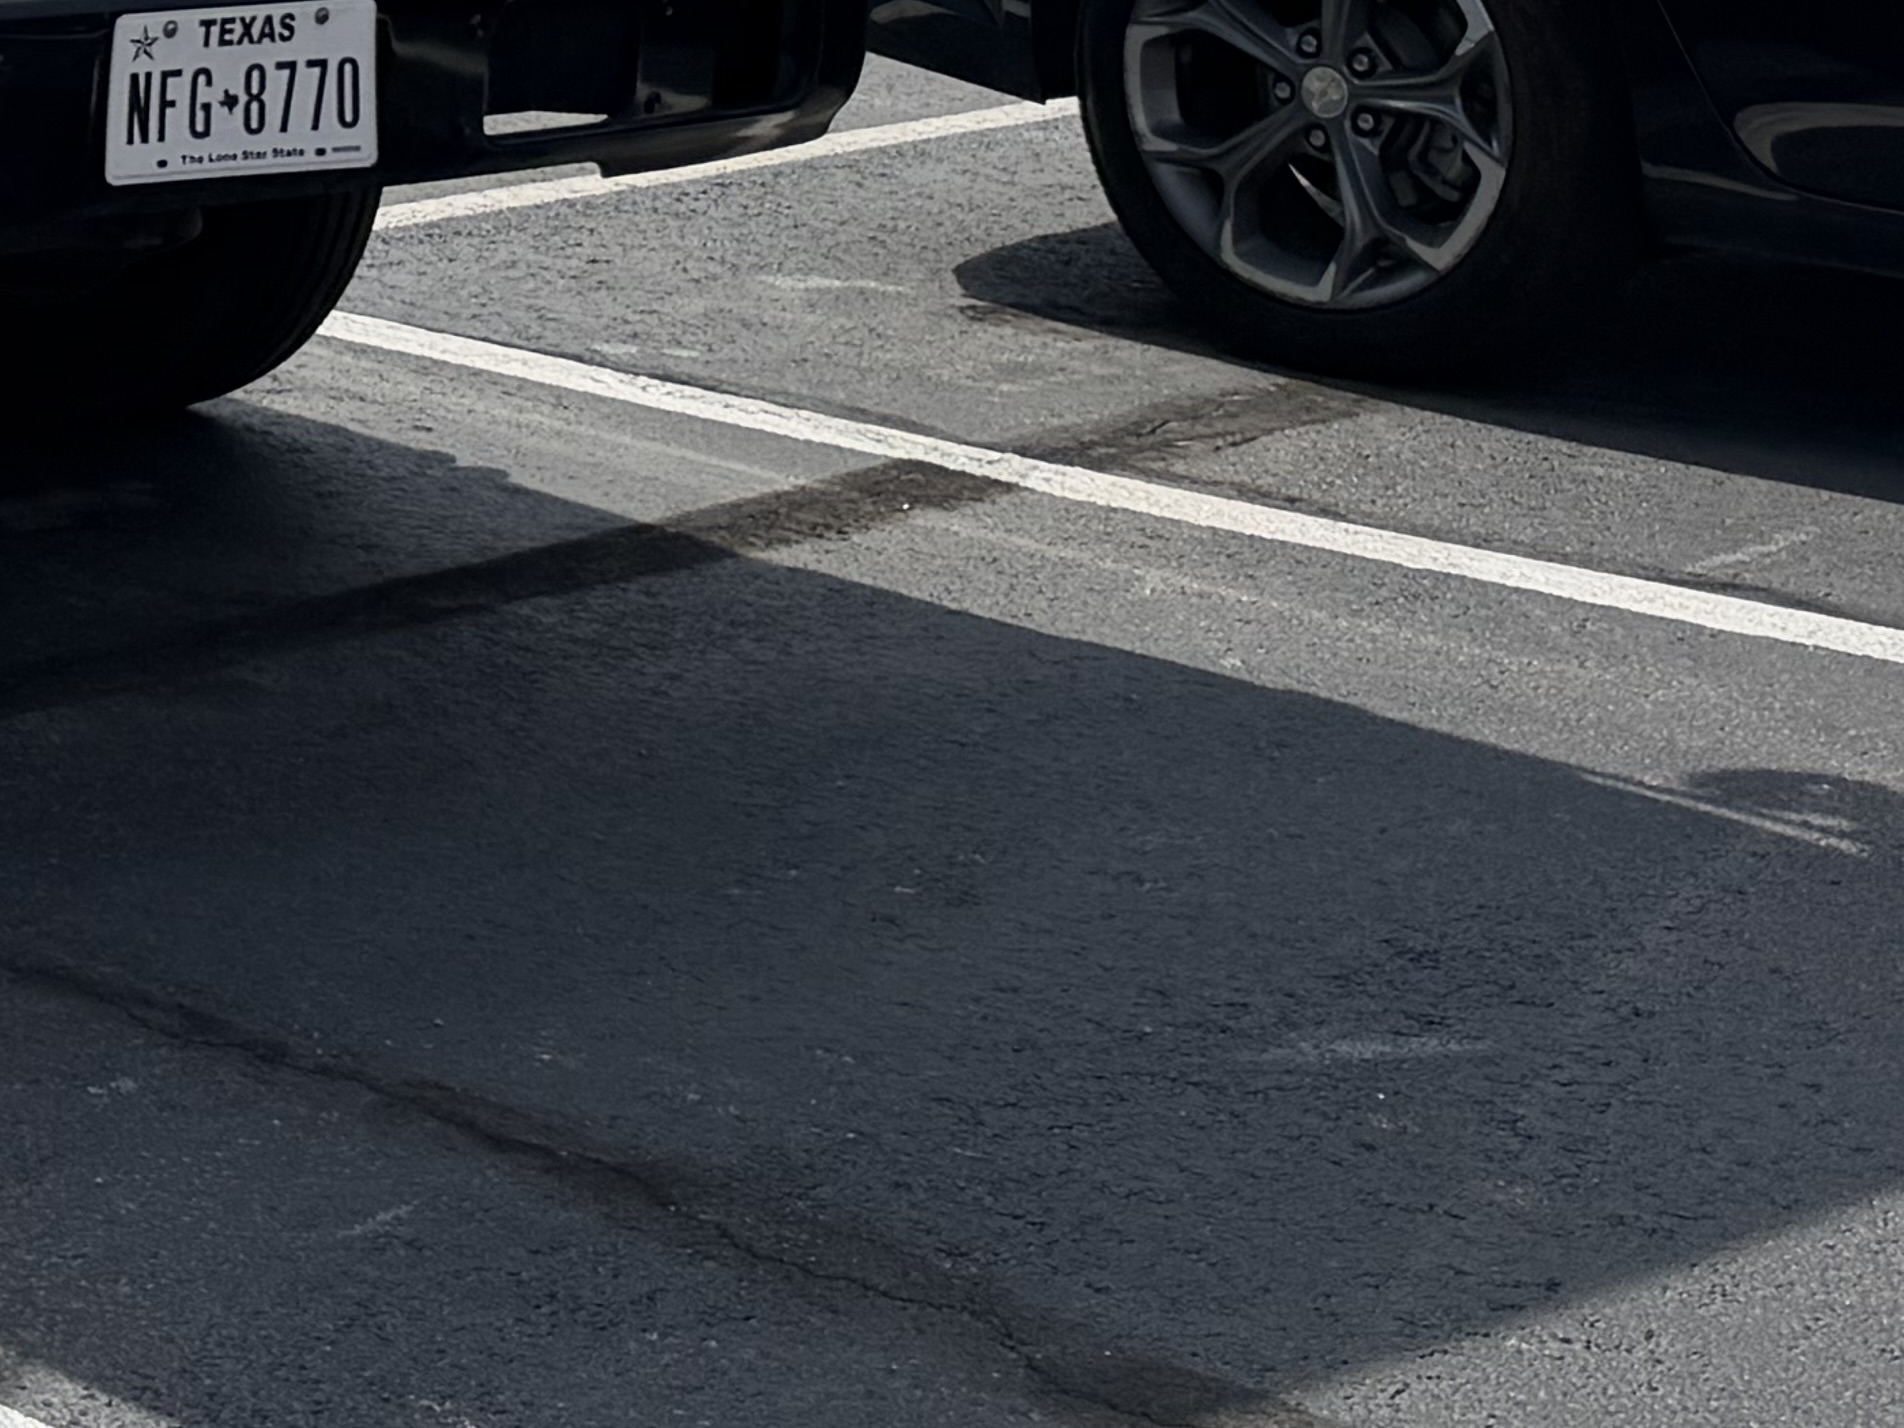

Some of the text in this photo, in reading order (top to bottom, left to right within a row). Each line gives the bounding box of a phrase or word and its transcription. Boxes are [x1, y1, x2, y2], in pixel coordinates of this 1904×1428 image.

[199, 13, 296, 48] TEXAS
[181, 147, 305, 165] The Lone Star State
